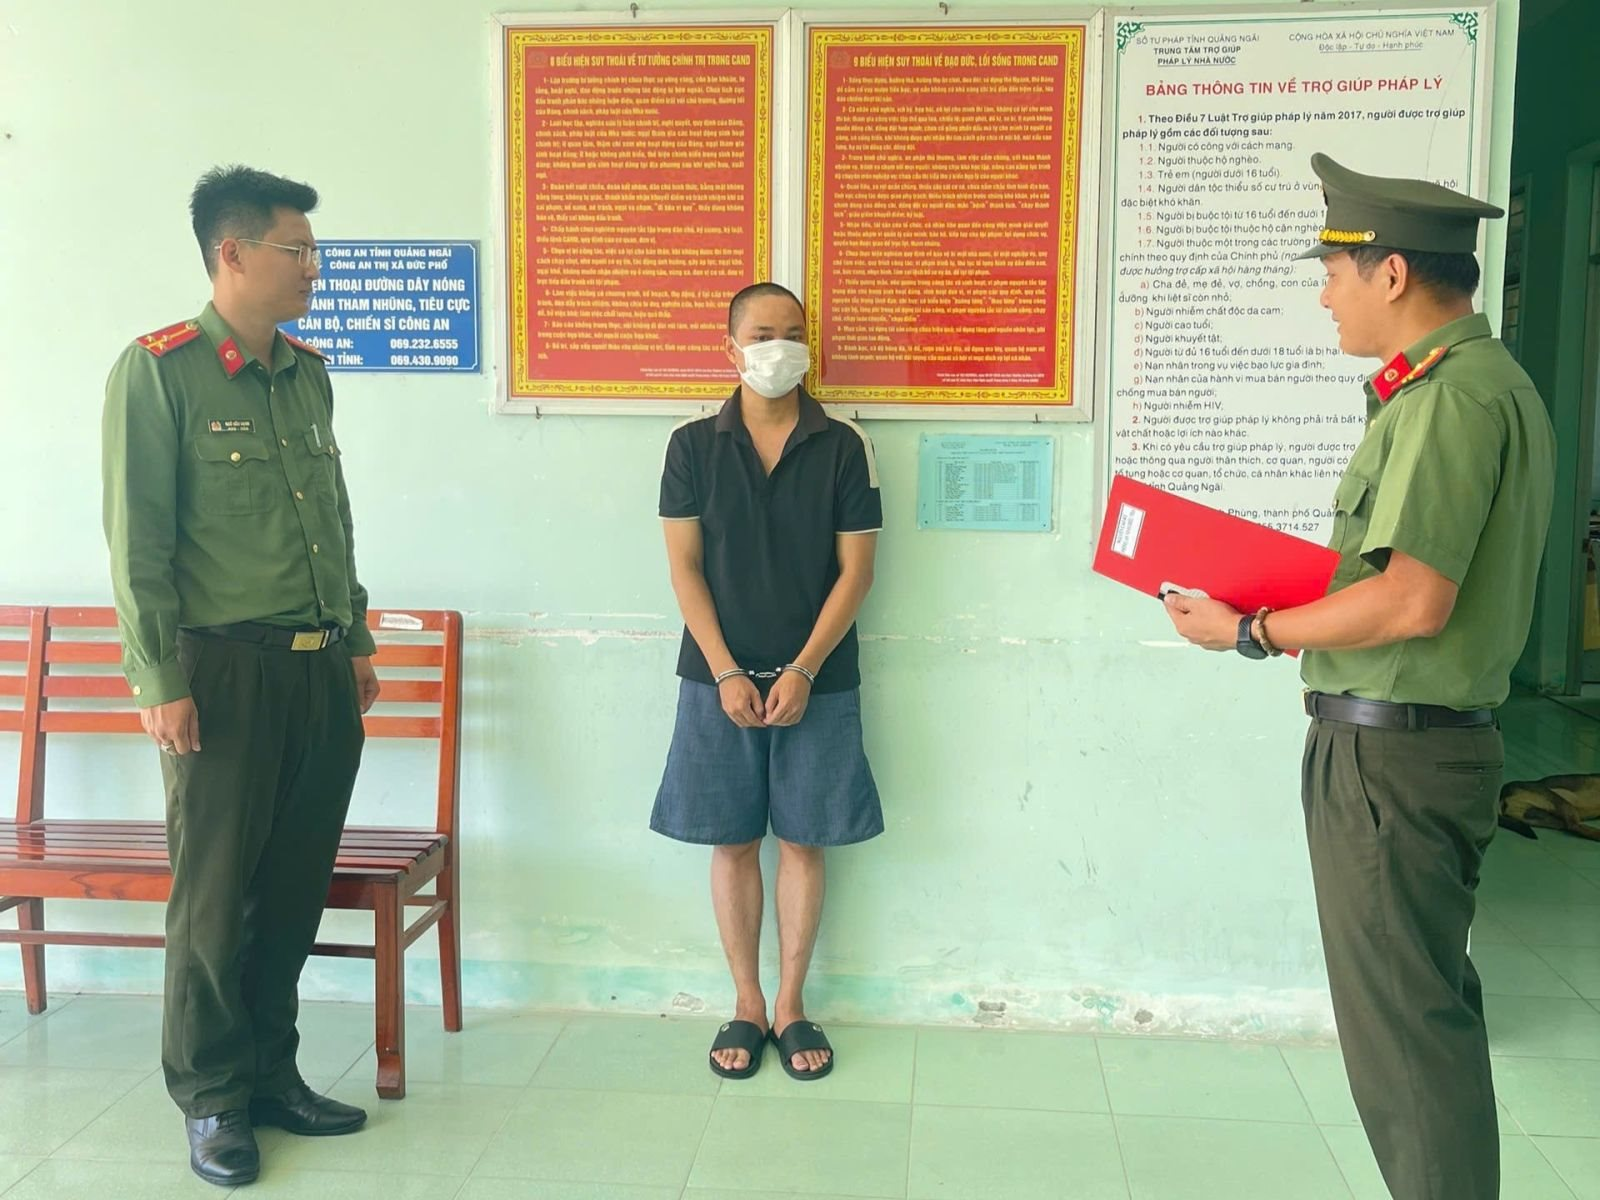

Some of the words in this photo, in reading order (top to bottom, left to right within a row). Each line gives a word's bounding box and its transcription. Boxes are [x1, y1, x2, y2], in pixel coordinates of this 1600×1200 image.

[1184, 45, 1200, 53] TÂM
[1203, 46, 1219, 54] TRỢ
[1221, 45, 1241, 53] GIÚP
[1157, 57, 1179, 65] PHÁP
[1146, 79, 1187, 95] BẢNG
[1192, 80, 1243, 94] THÔNG
[1249, 82, 1272, 93] TIN
[1278, 77, 1296, 93] VỀ
[1301, 80, 1332, 94] TRỢ
[1337, 77, 1372, 91] GIÚP
[1378, 75, 1418, 90] PHÁP
[1424, 74, 1442, 89] LÝ
[1138, 115, 1145, 123] 1.
[1148, 114, 1173, 123] Theo
[1175, 112, 1197, 122] Điều
[1200, 113, 1205, 122] 7
[1208, 113, 1229, 123] Luật
[1231, 112, 1248, 122] Trợ
[1250, 112, 1272, 123] giúp
[1275, 112, 1300, 122] pháp
[1303, 111, 1311, 122] lý
[1314, 111, 1335, 119] năm
[1338, 110, 1364, 120] 2017,
[1367, 109, 1395, 120] người
[1398, 109, 1423, 119] được
[1426, 109, 1440, 118] trợ
[1442, 107, 1465, 119] giúp
[1122, 129, 1147, 139] pháp
[1149, 129, 1158, 139] lý
[1159, 127, 1181, 139] gồm
[1183, 128, 1200, 136] các
[1202, 127, 1218, 136] đối
[1220, 128, 1249, 137] tượng
[325, 247, 351, 257] CÔNG
[353, 248, 367, 257] AN
[369, 246, 391, 256] TỈNH
[393, 246, 426, 257] QUẢNG
[428, 247, 451, 256] NGÃI
[329, 259, 355, 269] CÔNG
[357, 261, 371, 269] AN
[373, 261, 388, 271] THỊ
[391, 259, 404, 269] XÃ
[406, 259, 425, 269] ĐỨC
[428, 258, 447, 269] PHỐ
[328, 278, 361, 293] THOẠI
[364, 277, 403, 291] ĐƯỜNG
[406, 277, 429, 291] DÂY
[432, 277, 465, 291] NÓNG
[310, 297, 334, 310] ẢNH
[337, 298, 369, 310] THAM
[372, 297, 415, 311] NHŨNG,
[418, 297, 443, 310] TIÊU
[446, 297, 470, 313] CỰC
[298, 316, 321, 330] CÁN
[324, 315, 343, 332] BỘ,
[346, 315, 380, 330] CHIẾN
[383, 316, 395, 330] SĨ
[398, 315, 430, 330] CÔNG
[433, 318, 449, 330] AN
[336, 338, 353, 348] AN:
[390, 338, 458, 349] 069.232.6555
[336, 354, 363, 364] TỈNH:
[390, 355, 458, 365] 069.430.9090
